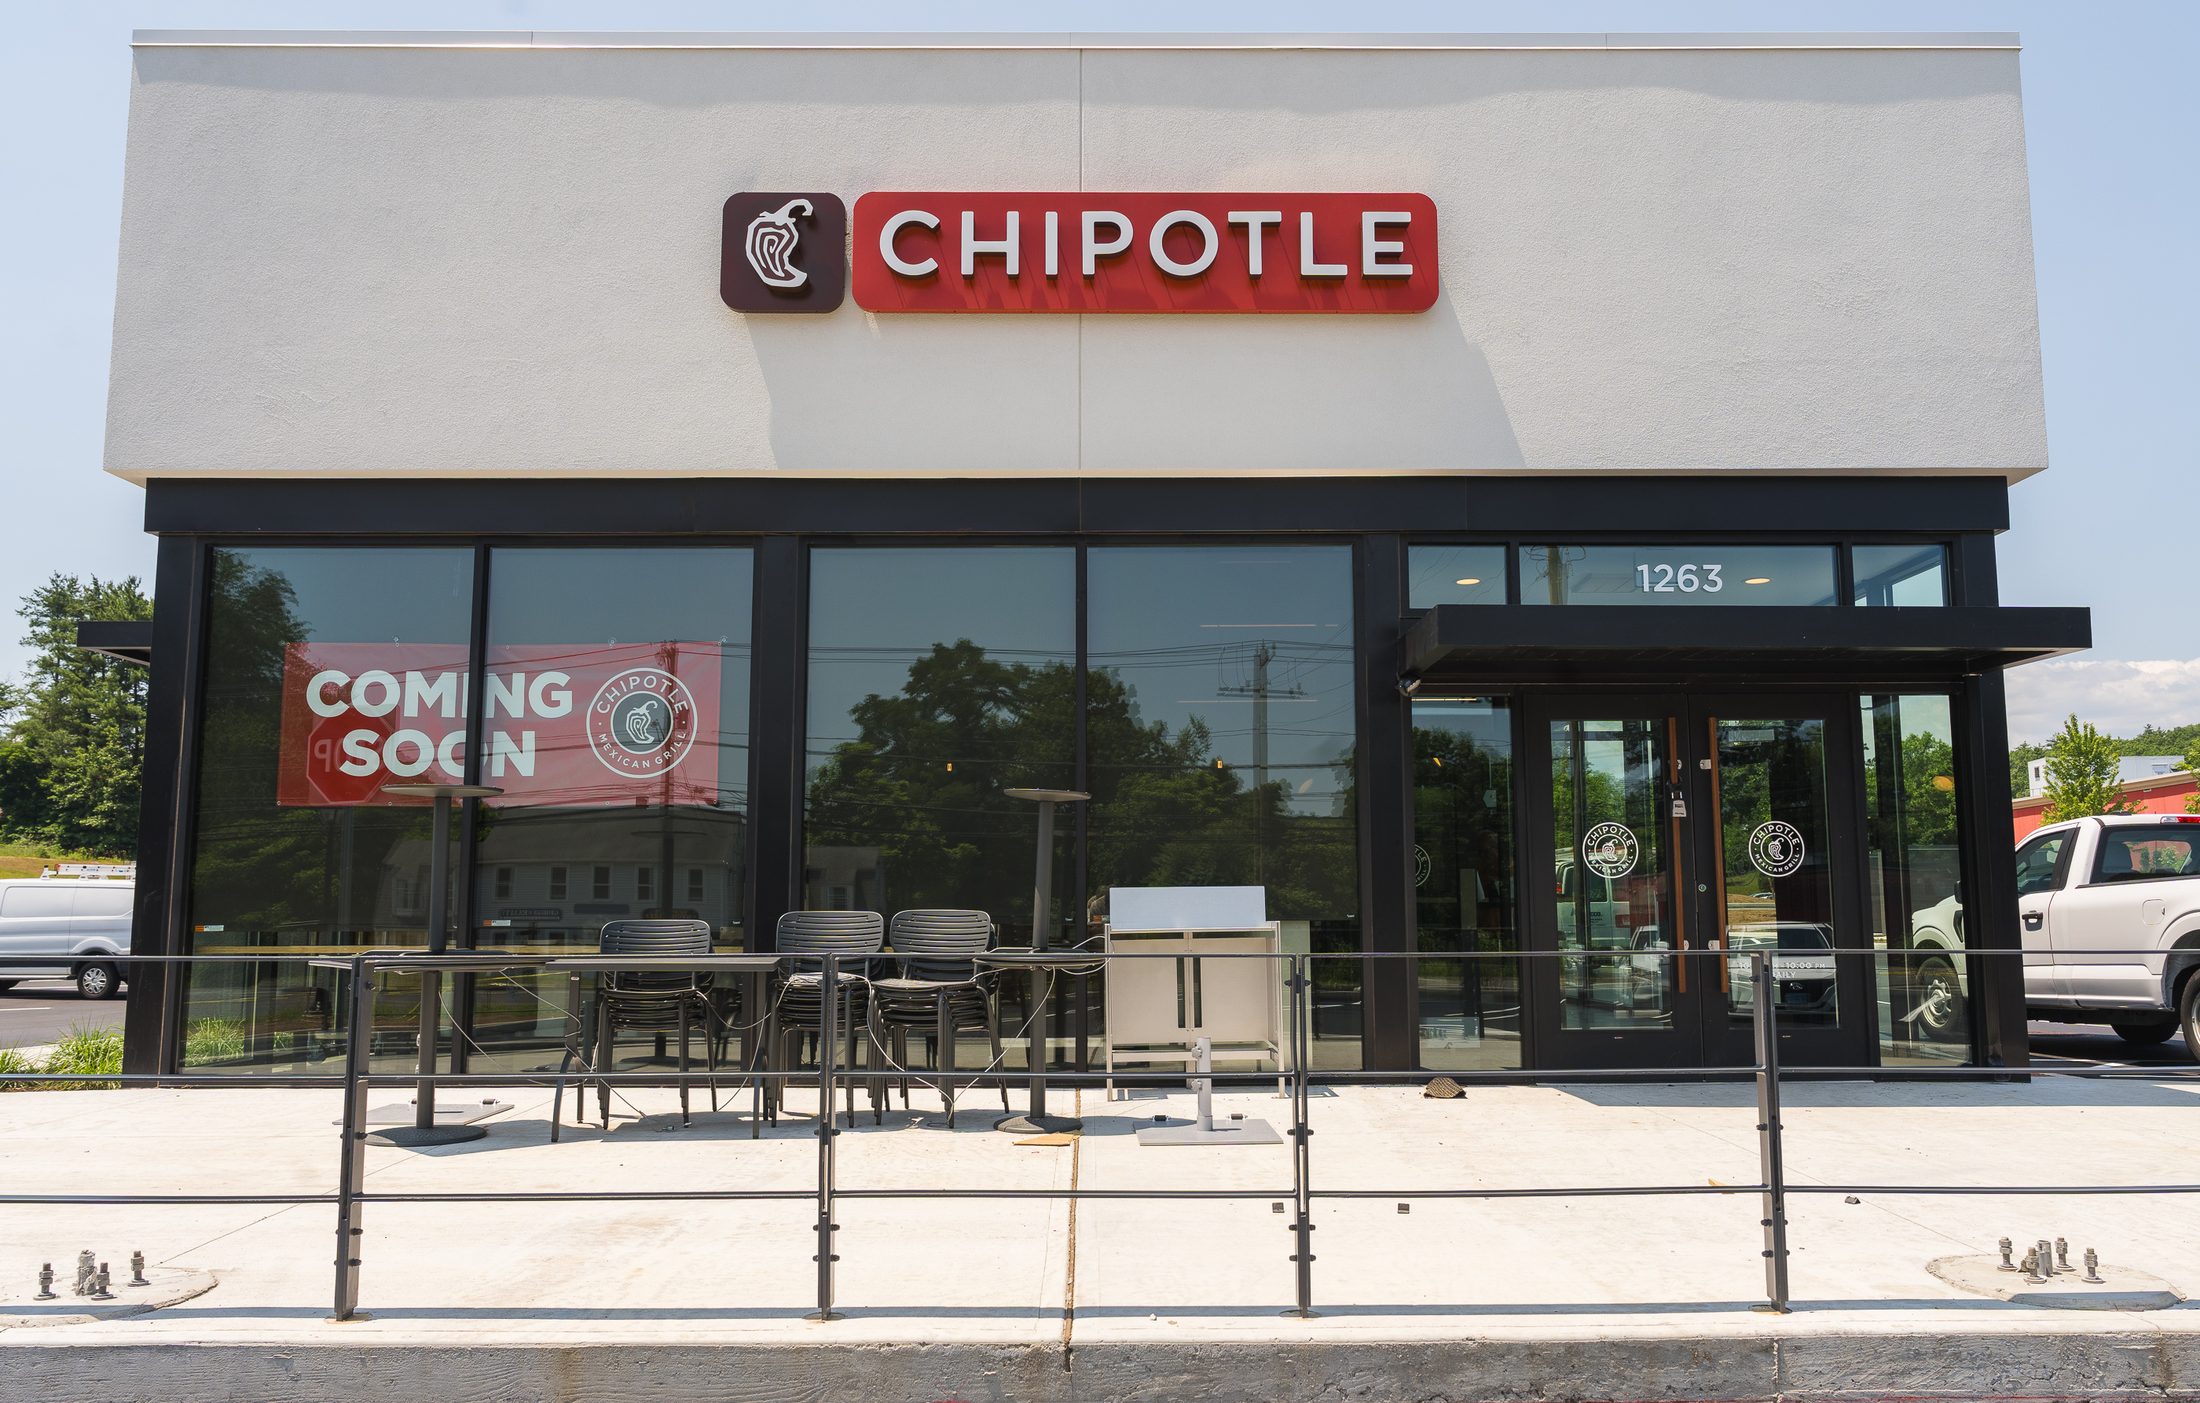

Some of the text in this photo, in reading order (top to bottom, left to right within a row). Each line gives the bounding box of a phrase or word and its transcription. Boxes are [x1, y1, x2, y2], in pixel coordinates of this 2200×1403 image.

[879, 210, 1413, 279] CHIPOTLE
[1636, 564, 1723, 593] 1263
[596, 675, 689, 714] CHIPOTLE
[339, 729, 536, 778] SOON
[599, 733, 686, 768] MEXICAN GRILL
[1587, 826, 1634, 846] CHIPOTLE
[1753, 825, 1800, 845] CHIPOTLE
[1618, 855, 1633, 871] GRILL
[1755, 853, 1799, 872] MEXICAN GRILL
